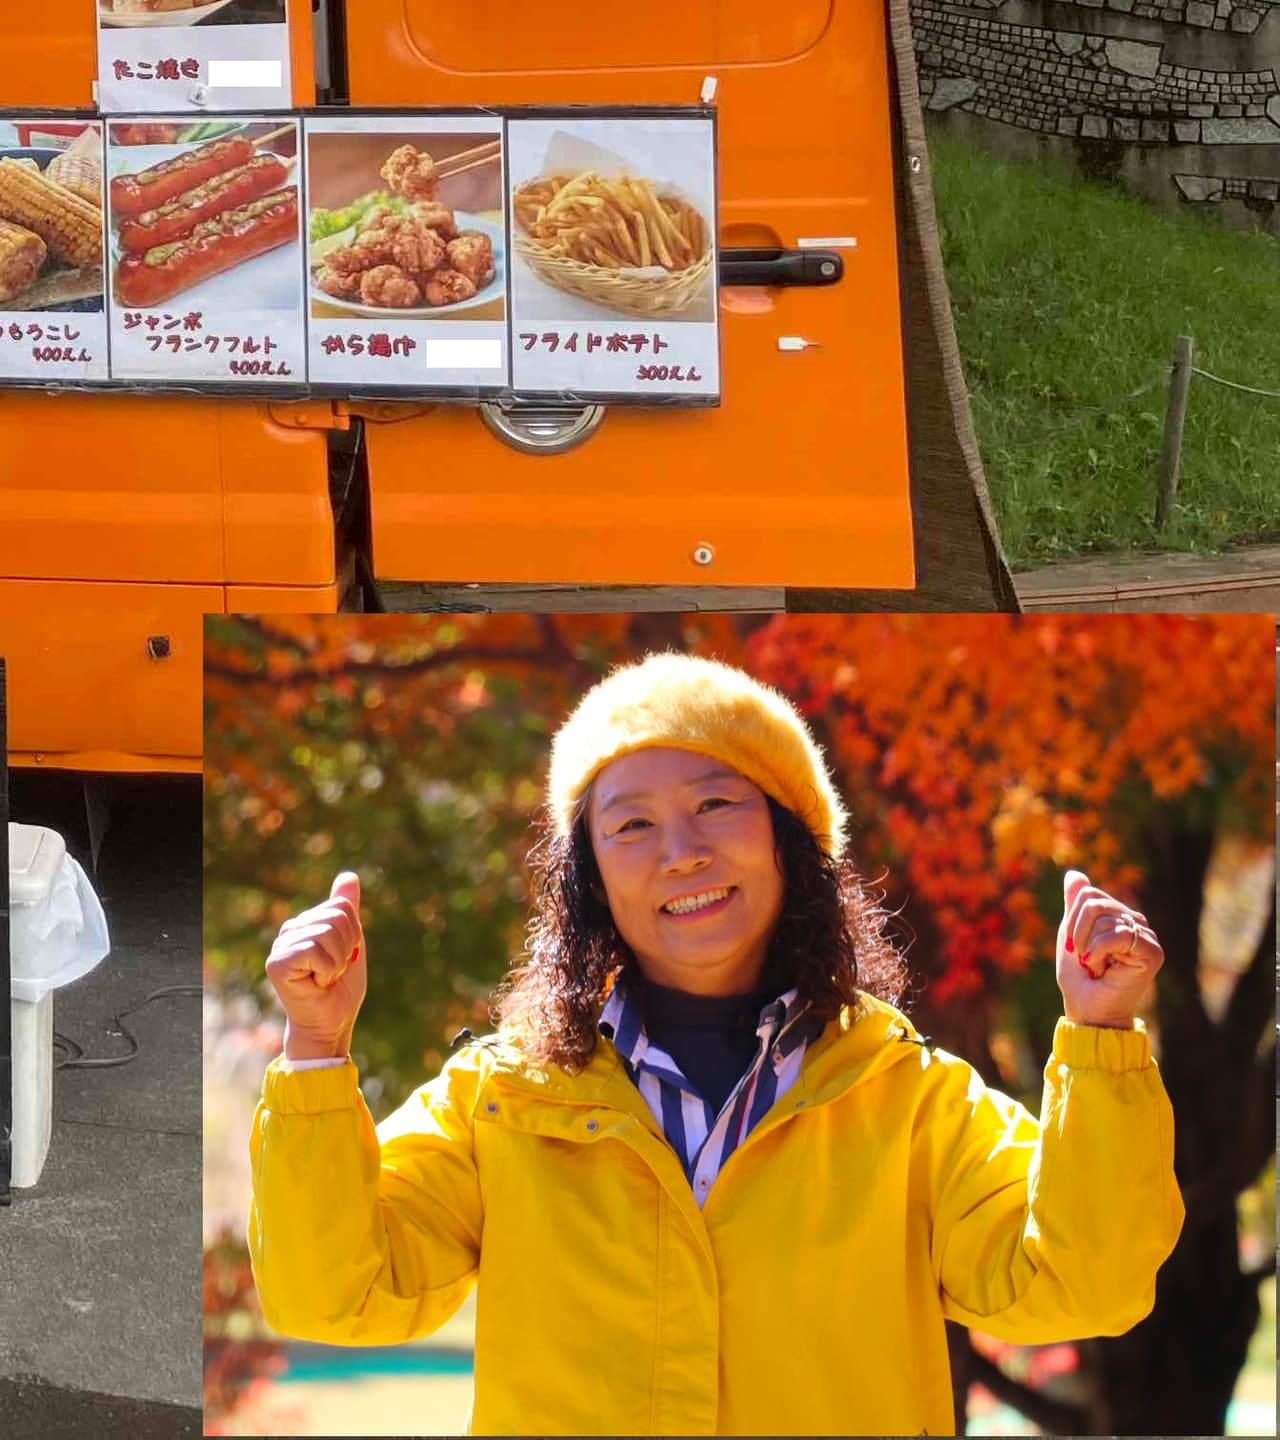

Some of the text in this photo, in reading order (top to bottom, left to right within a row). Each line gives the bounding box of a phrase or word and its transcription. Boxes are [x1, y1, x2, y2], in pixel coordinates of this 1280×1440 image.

[112, 58, 200, 80] たこ焼き
[123, 311, 203, 331] ジャンボ
[146, 334, 278, 354] フランクフルト
[321, 333, 416, 357] から揚げ
[519, 332, 669, 354] フライドポテト
[32, 346, 92, 362] 400えん
[229, 360, 292, 376] 400えん
[636, 365, 702, 381] 300えん
